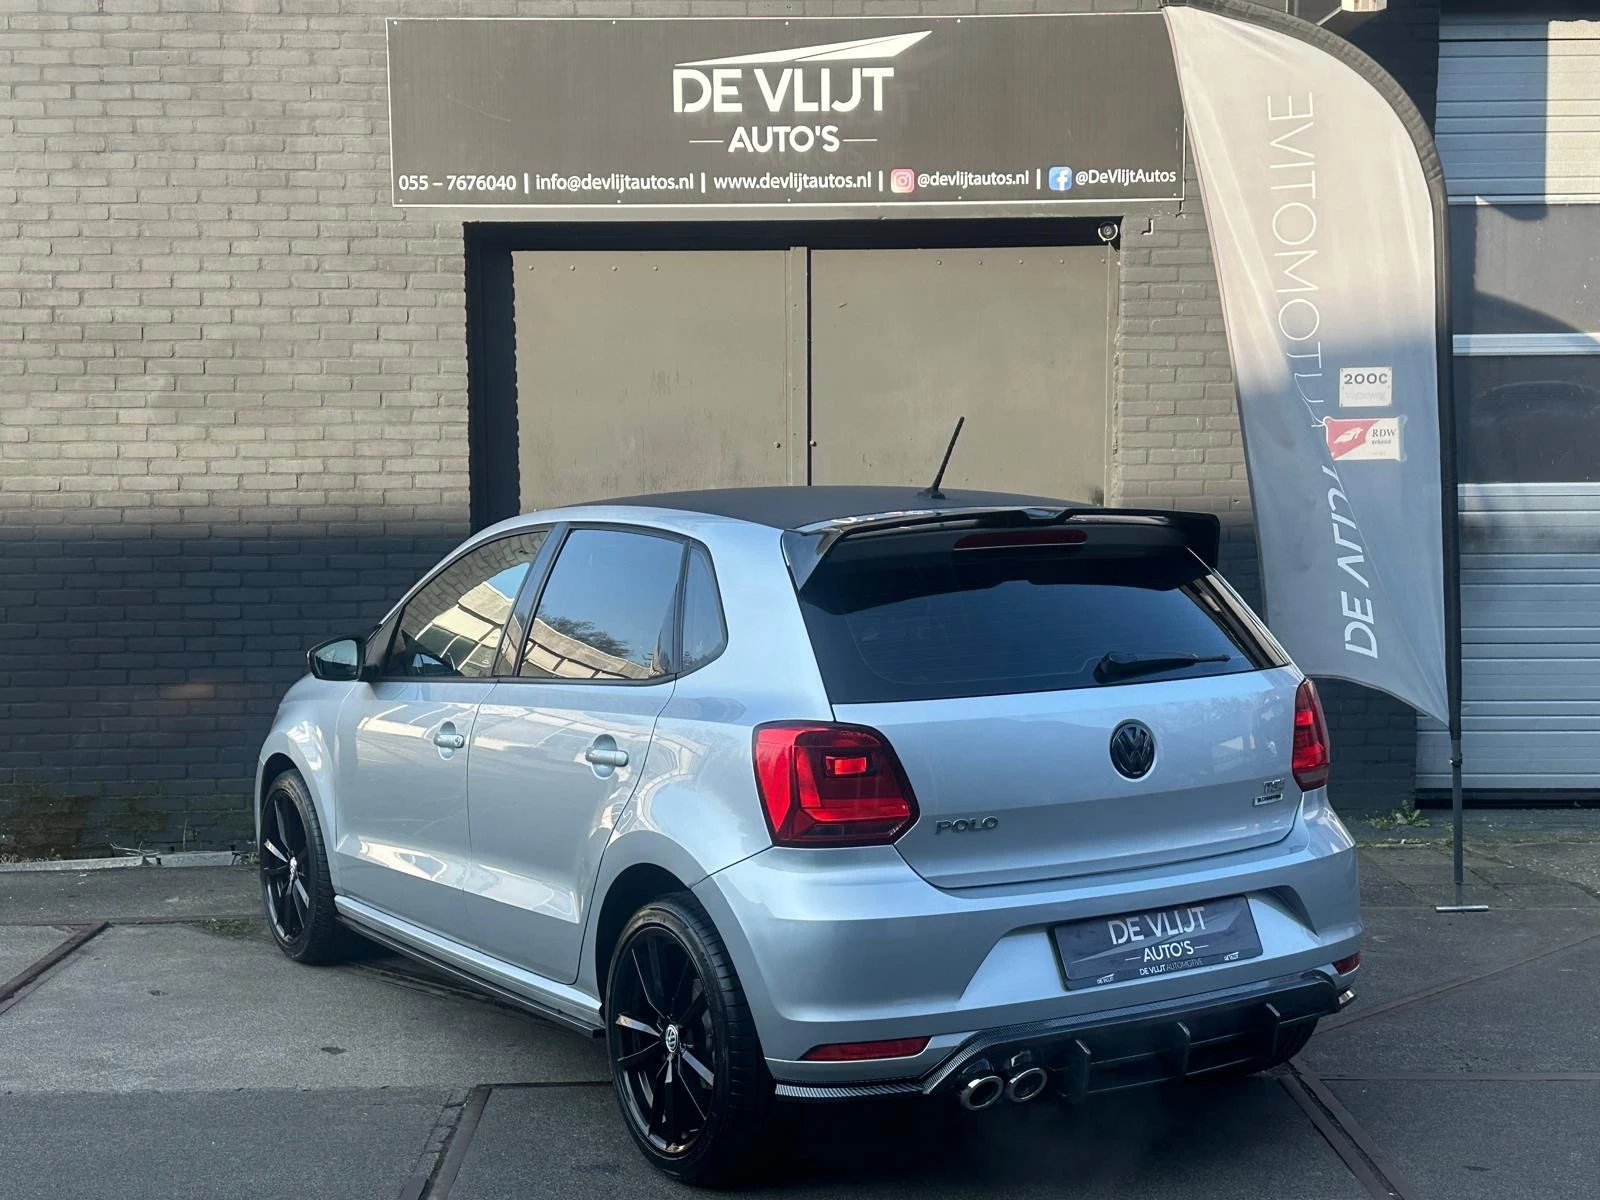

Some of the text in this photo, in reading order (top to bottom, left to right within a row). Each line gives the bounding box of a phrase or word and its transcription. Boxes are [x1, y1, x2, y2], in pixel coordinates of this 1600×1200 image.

[672, 66, 895, 113] DE VLIJT
[727, 124, 841, 154] AUTO'S
[398, 174, 428, 191] 055
[446, 173, 516, 191] 7676040
[535, 172, 694, 193] info@devlijtautos.nl
[713, 171, 872, 193] www.devlijtautos.nl
[917, 169, 1030, 189] @devlijtautos.nl
[1075, 168, 1177, 187] @DeVlijtAutos
[1371, 428, 1397, 438] RDW
[934, 815, 999, 835] POLO
[1107, 906, 1207, 945] DE VLIJT
[1143, 940, 1195, 963] AUTO'S
